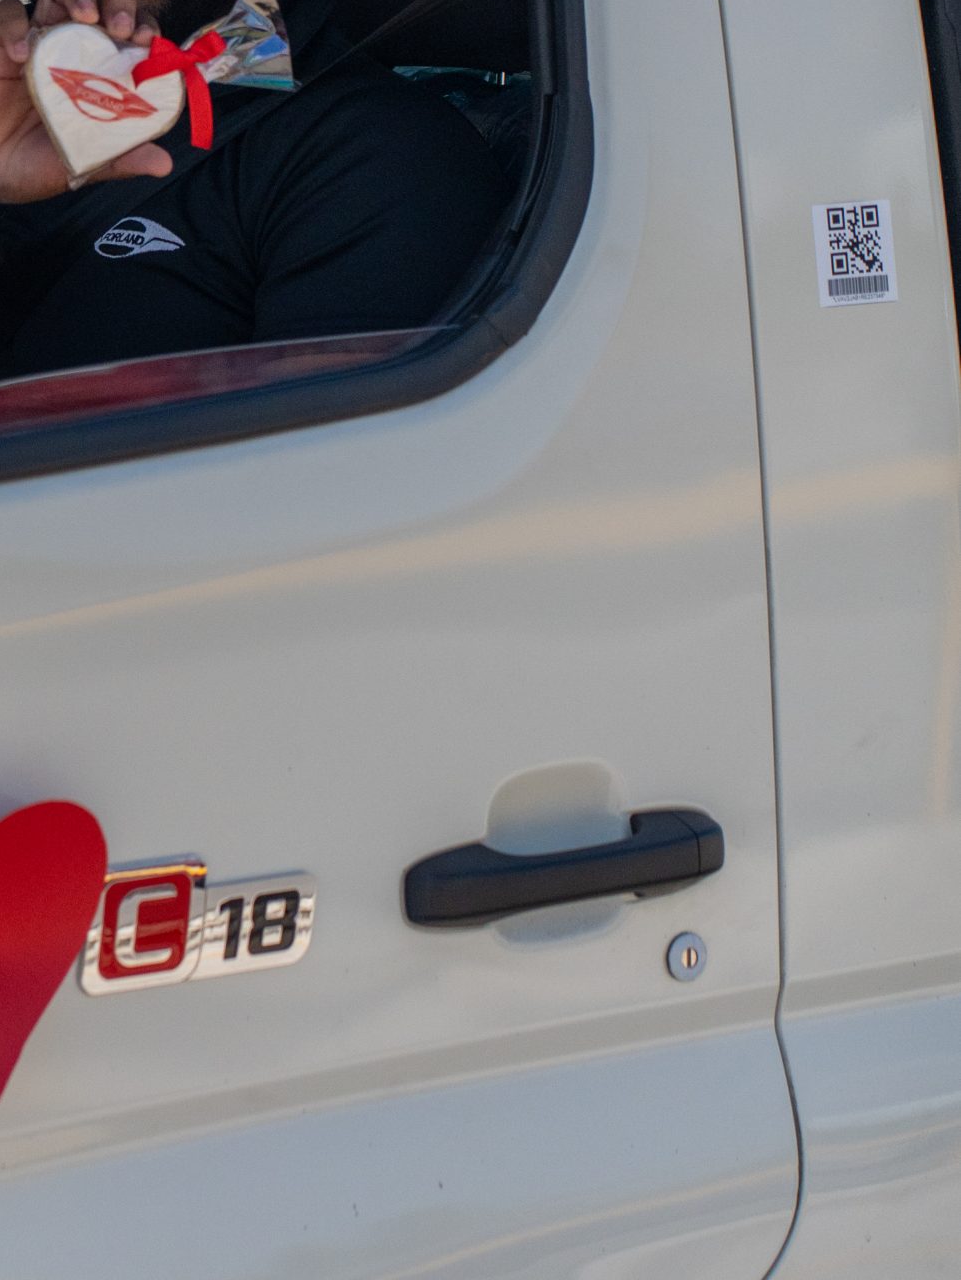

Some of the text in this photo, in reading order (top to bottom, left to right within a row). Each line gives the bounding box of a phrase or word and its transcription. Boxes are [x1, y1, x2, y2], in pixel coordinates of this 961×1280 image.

[76, 86, 125, 112] FORLAND
[102, 232, 145, 246] FORLAND
[219, 889, 301, 961] 18
